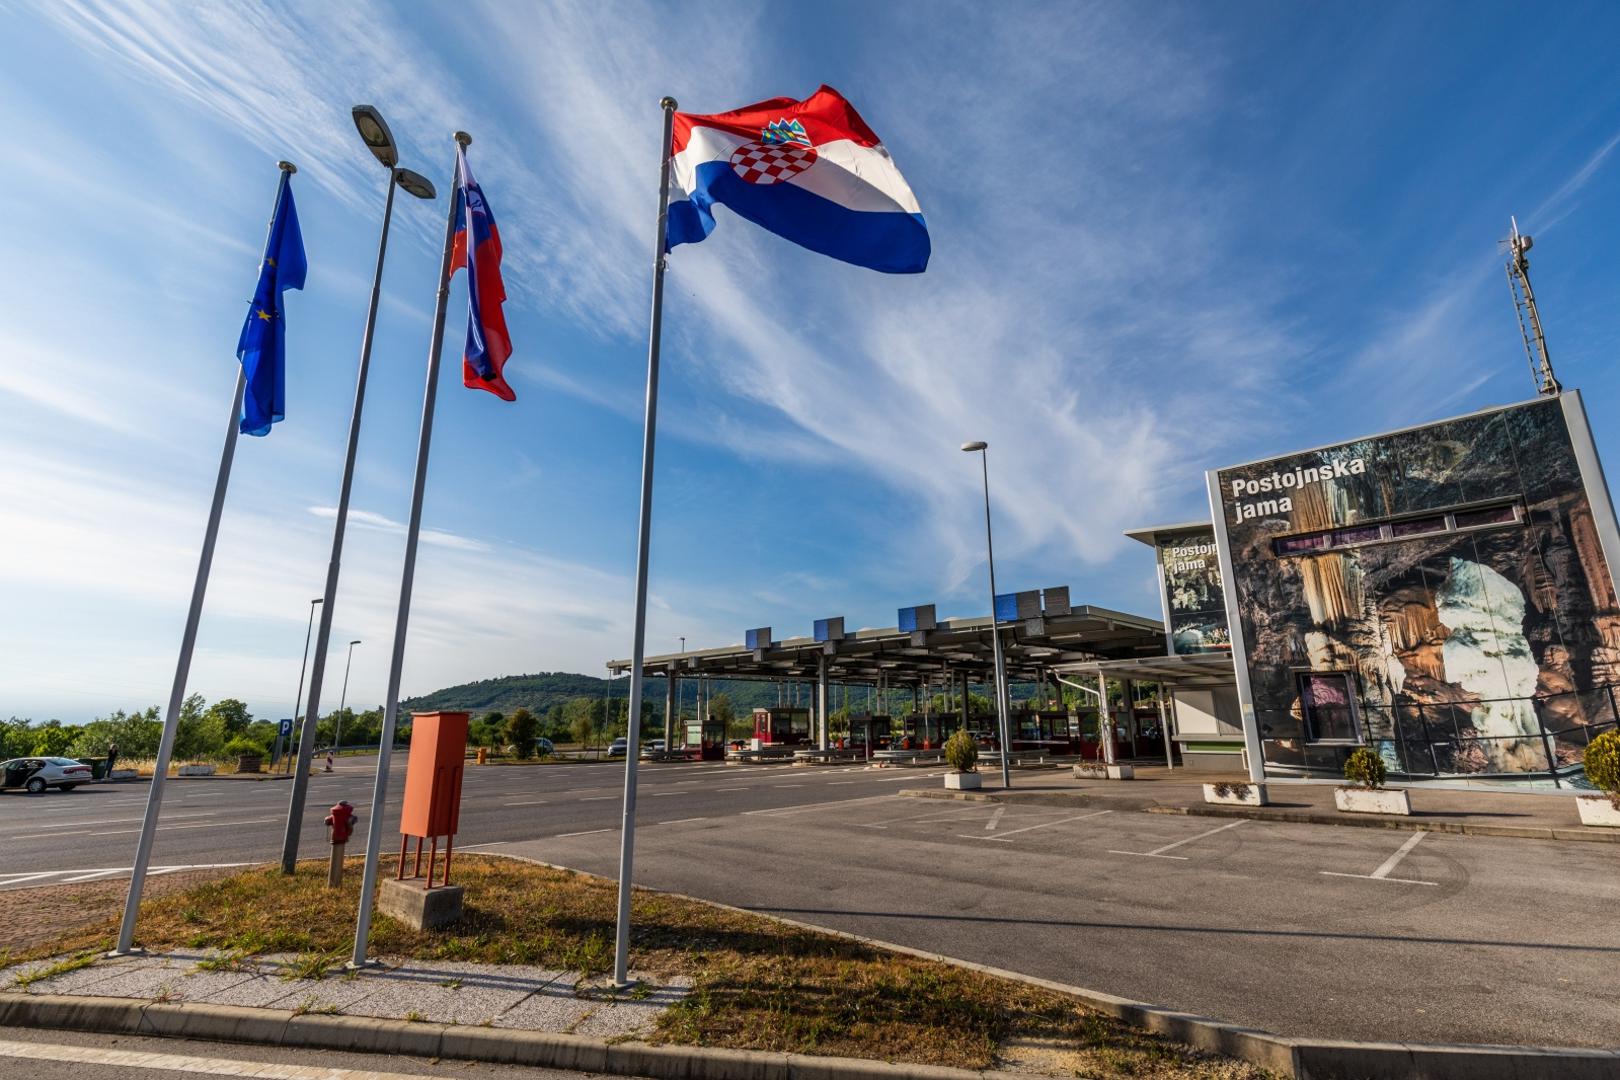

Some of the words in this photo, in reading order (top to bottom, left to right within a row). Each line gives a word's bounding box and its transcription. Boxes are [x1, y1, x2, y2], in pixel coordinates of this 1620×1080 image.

[1232, 458, 1366, 497] Postojnska
[1235, 497, 1293, 524] jama
[1174, 559, 1206, 574] jama
[281, 721, 290, 734] P
